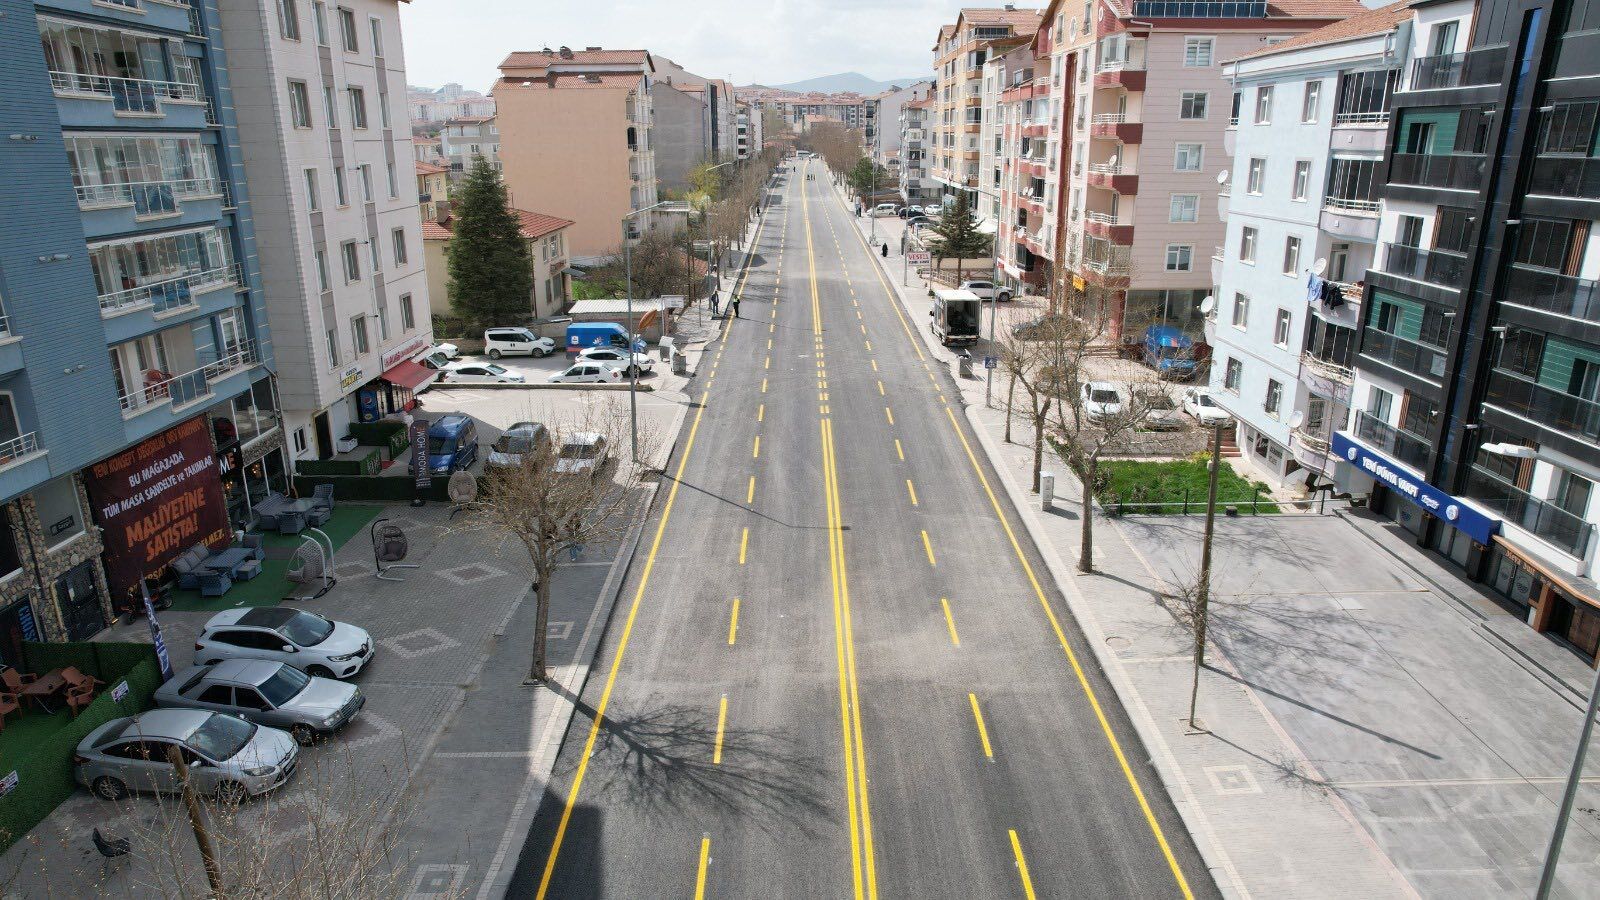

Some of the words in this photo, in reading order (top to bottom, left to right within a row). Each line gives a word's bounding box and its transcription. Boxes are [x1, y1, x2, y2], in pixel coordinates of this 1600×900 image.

[128, 472, 141, 488] BU
[142, 451, 184, 480] MAĞAZADA
[1362, 457, 1378, 473] YENİ
[1376, 465, 1397, 485] DÜNYA
[102, 502, 121, 519] TÜM
[120, 492, 146, 512] MASA
[125, 486, 206, 549] MALİYETİNE
[145, 513, 198, 562] SATIŞTA!
